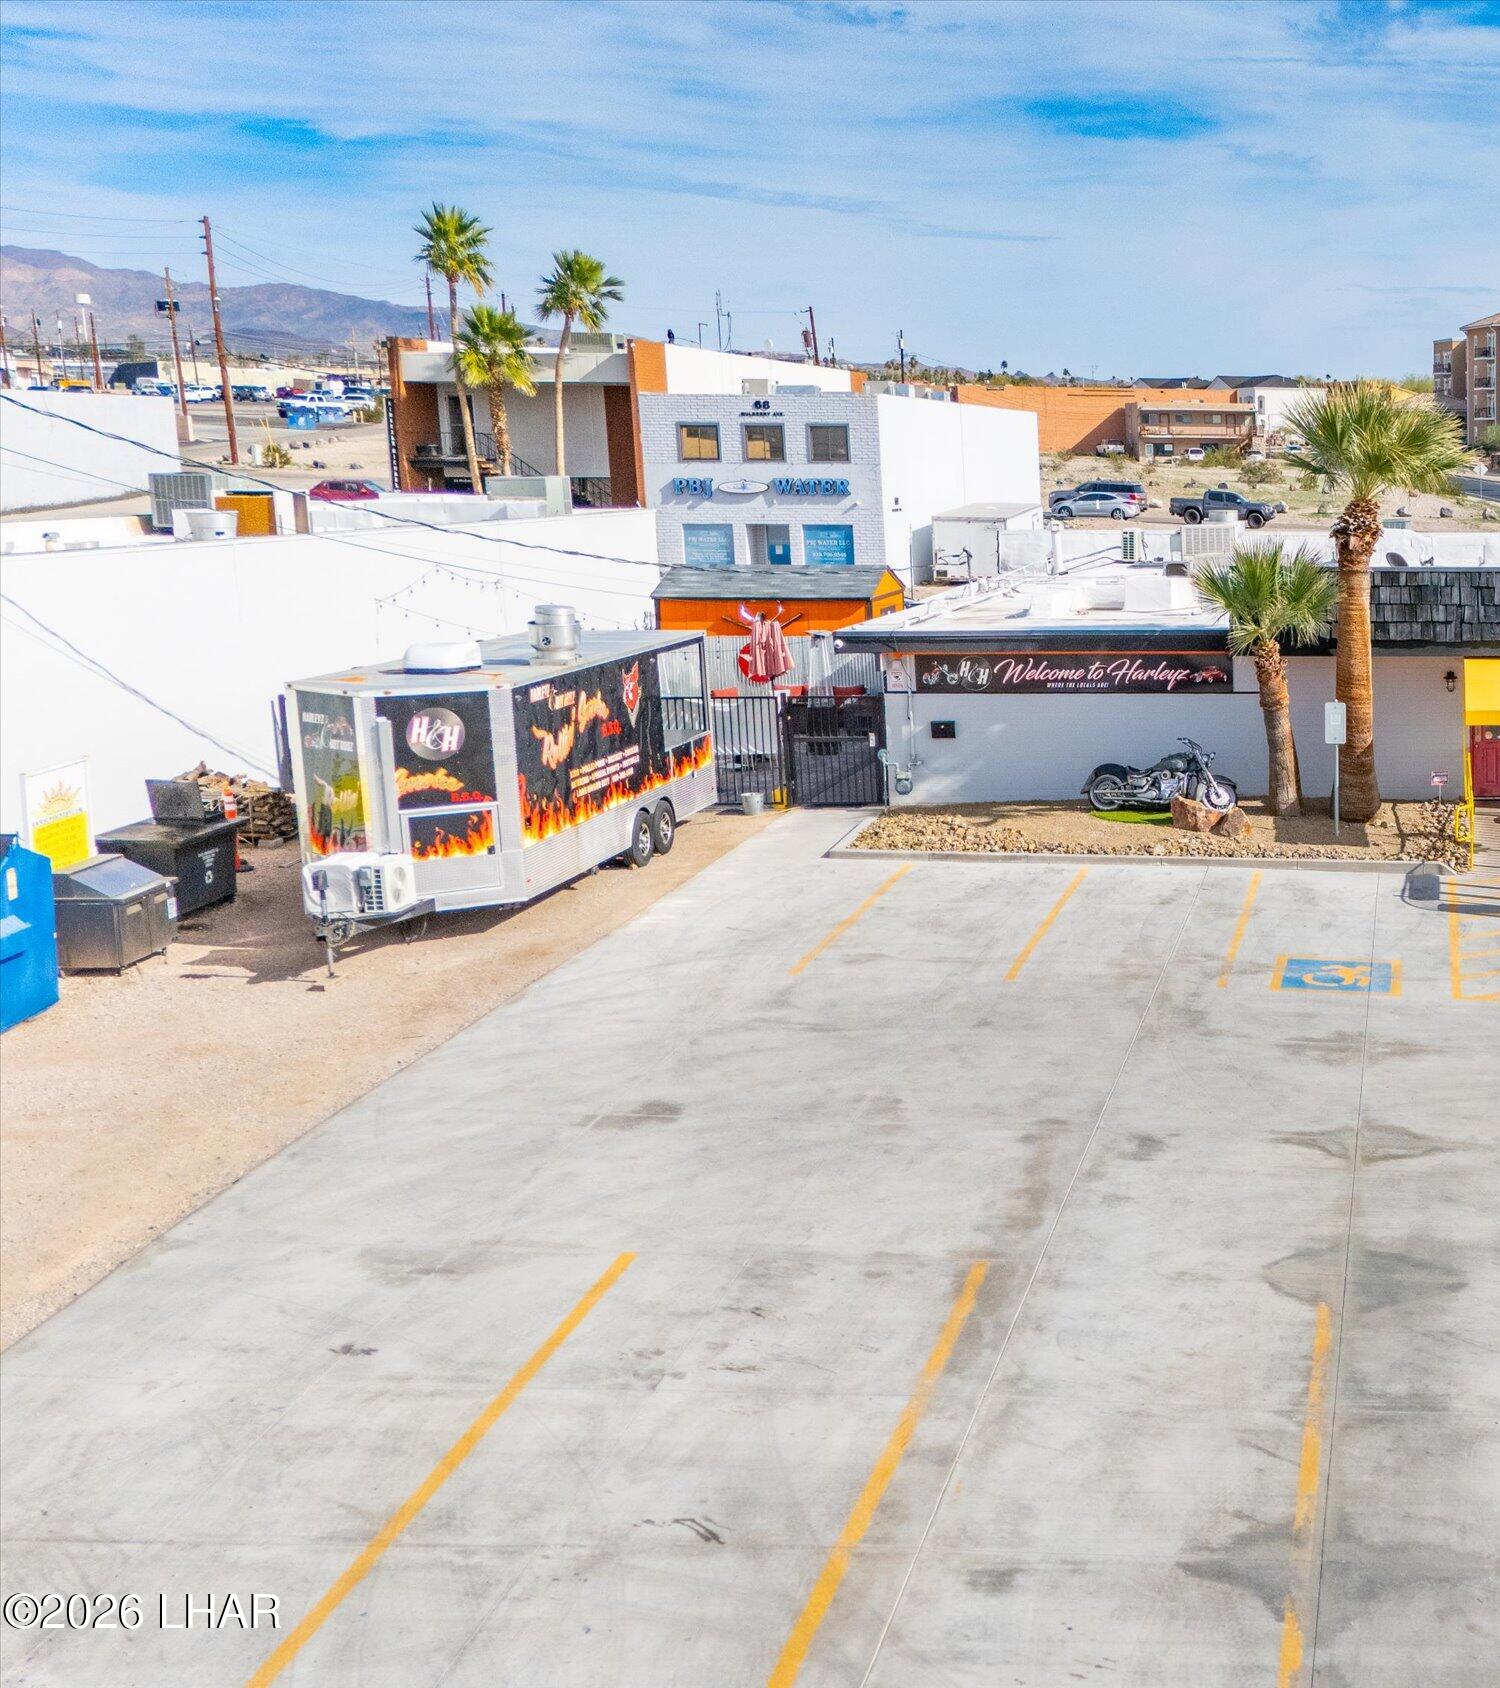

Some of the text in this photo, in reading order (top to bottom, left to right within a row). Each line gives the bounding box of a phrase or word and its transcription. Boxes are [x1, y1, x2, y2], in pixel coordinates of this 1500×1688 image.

[754, 400, 770, 410] 68
[673, 478, 851, 498] PBJ WATER
[994, 658, 1190, 690] Welcome to Harleyz
